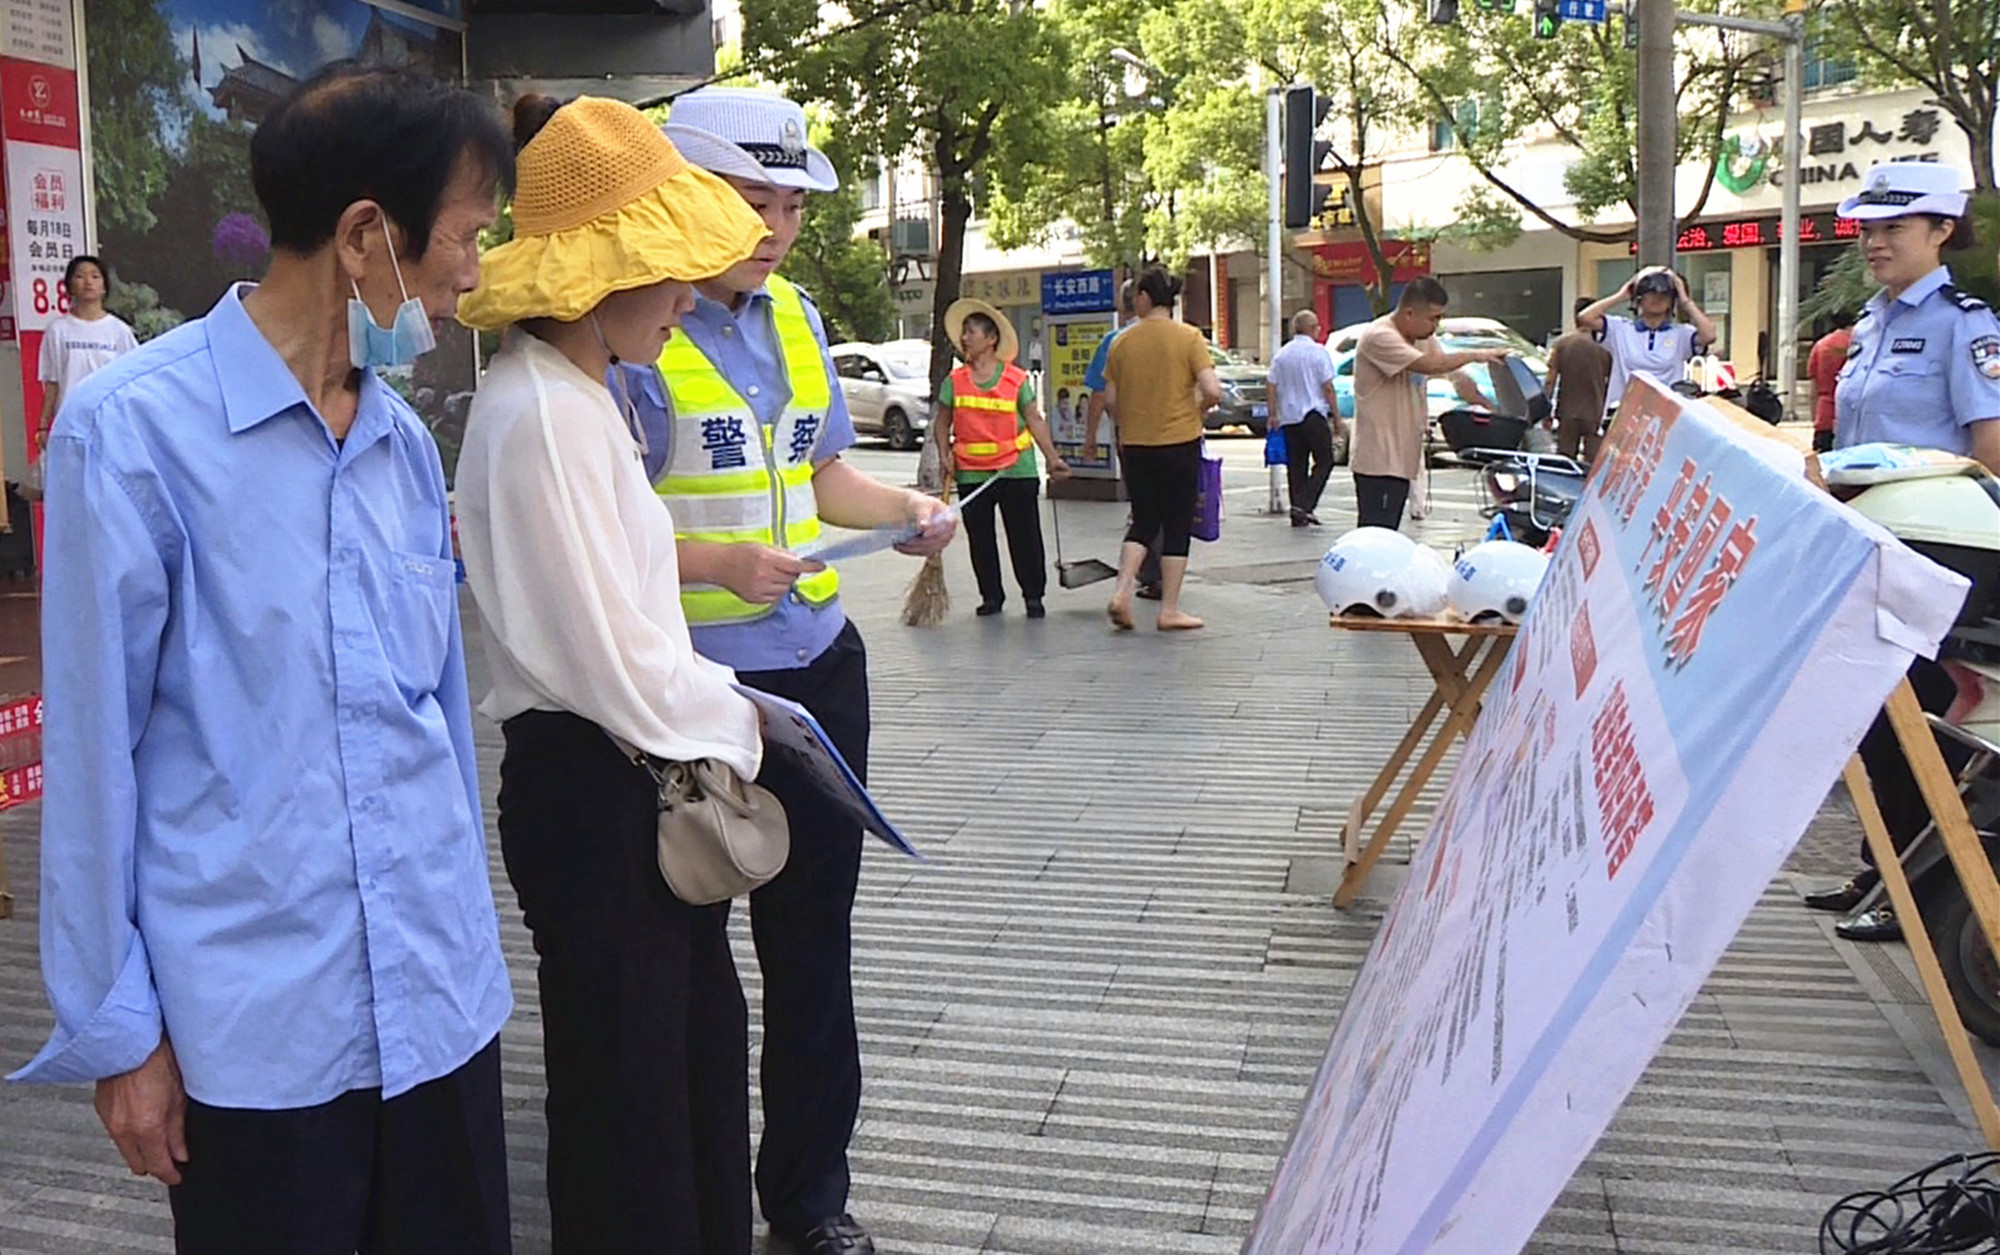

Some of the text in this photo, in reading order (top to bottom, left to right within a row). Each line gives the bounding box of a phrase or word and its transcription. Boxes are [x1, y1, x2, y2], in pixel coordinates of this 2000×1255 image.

[33, 173, 64, 192] 会员
[34, 192, 65, 212] 福利
[27, 219, 72, 238] 每月18日
[28, 241, 73, 260] 会员日
[1635, 455, 1759, 674] 平安回家
